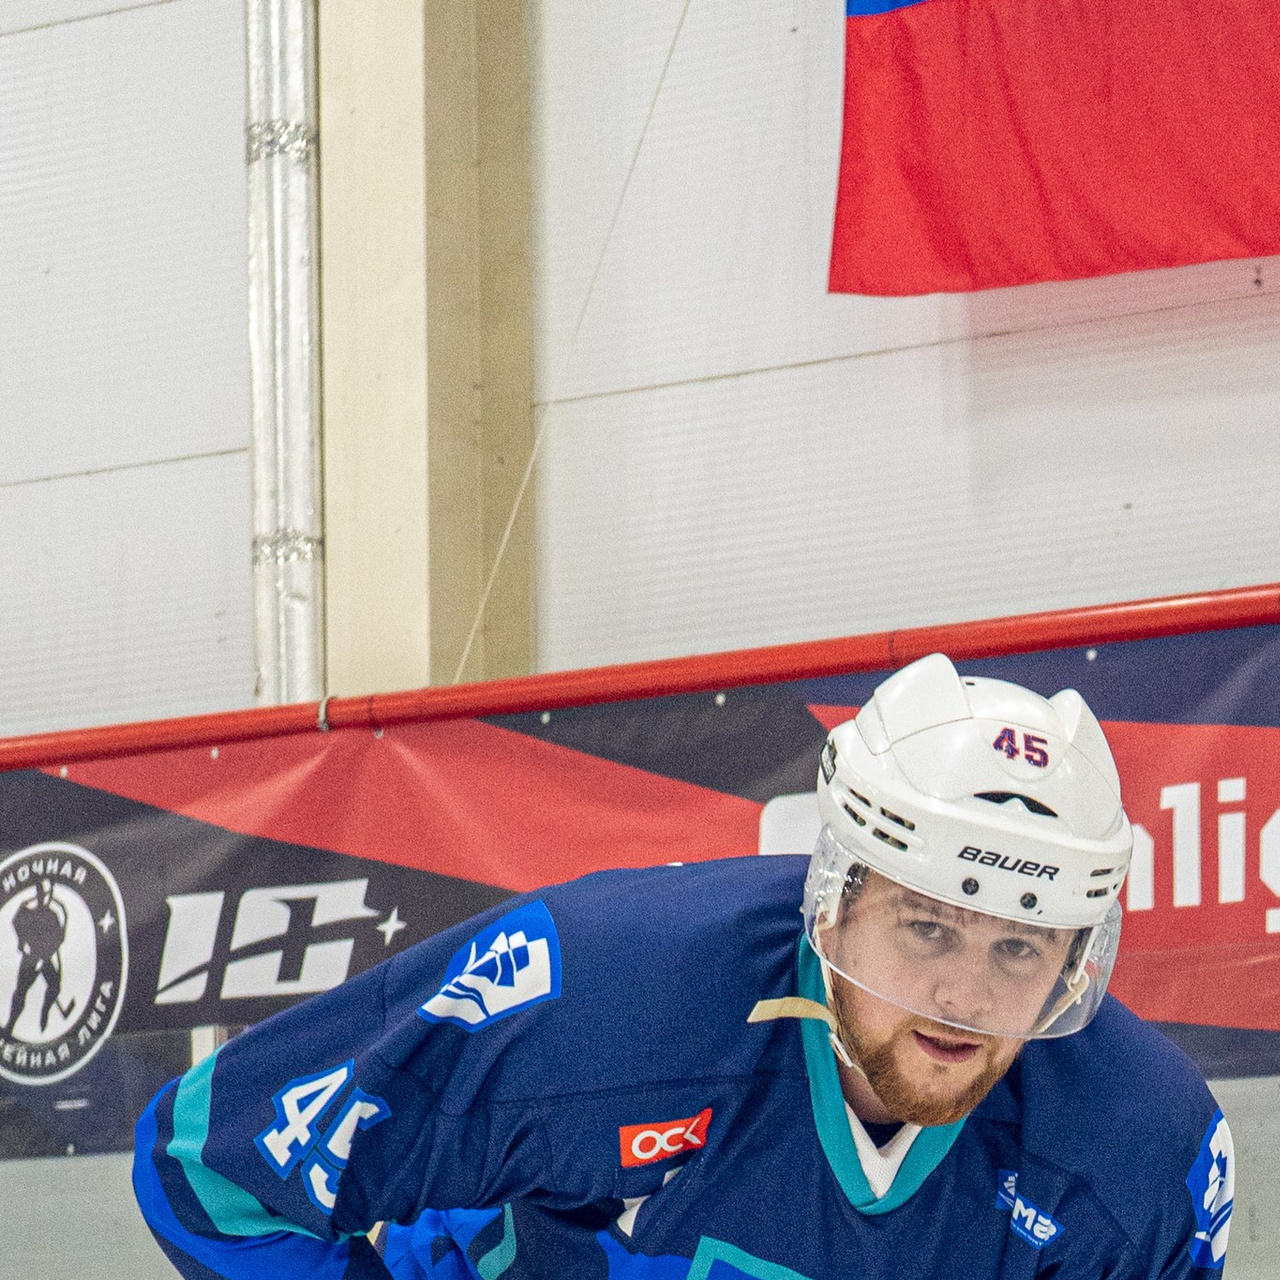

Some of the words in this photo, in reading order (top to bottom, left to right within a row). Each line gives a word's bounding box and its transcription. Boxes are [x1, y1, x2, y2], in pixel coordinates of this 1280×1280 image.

[992, 727, 1049, 769] 45
[2, 858, 87, 893] НОЧНАЯ
[957, 845, 1060, 881] BAUER
[0, 1038, 70, 1068] ЕЙНАЯ
[77, 980, 114, 1046] ЛИГА
